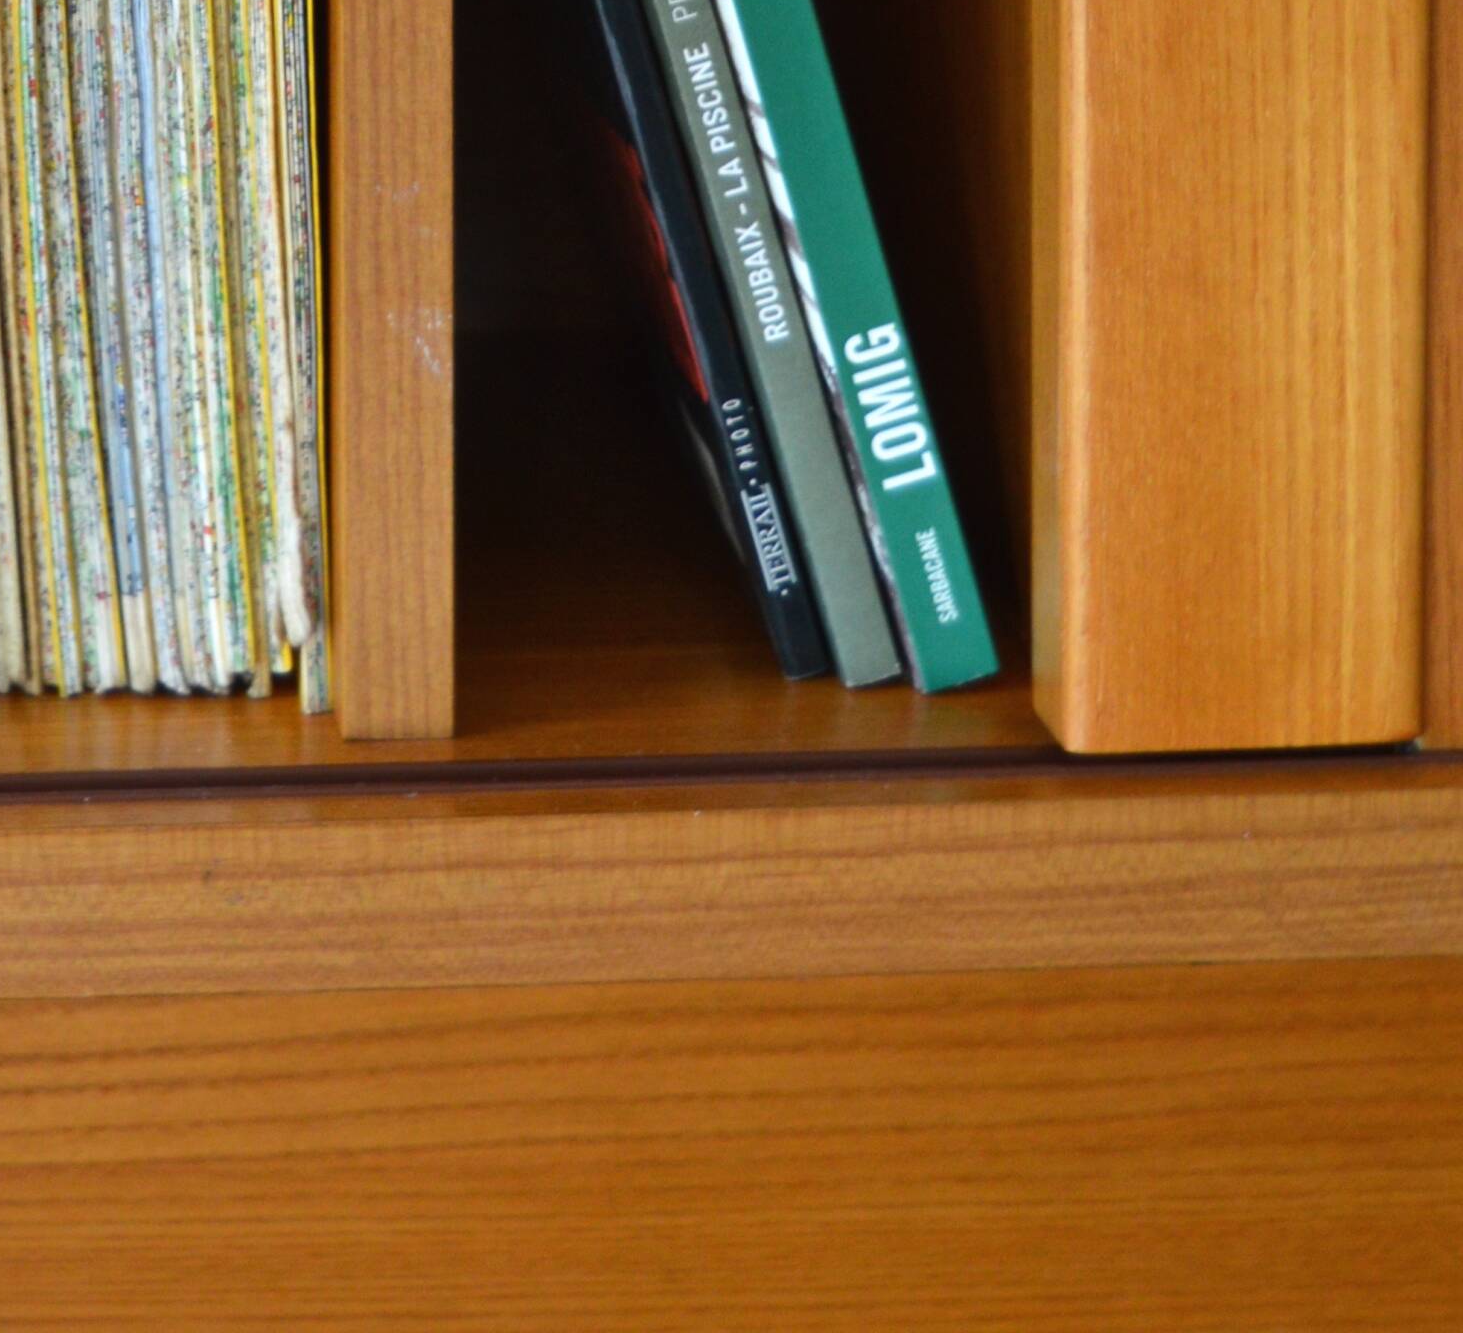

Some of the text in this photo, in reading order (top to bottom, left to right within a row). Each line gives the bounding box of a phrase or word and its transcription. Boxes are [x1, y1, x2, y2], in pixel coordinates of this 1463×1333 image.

[683, 42, 738, 153] PISCINE
[718, 155, 750, 201] LA
[735, 221, 789, 342] ROUBAIX
[844, 322, 937, 491] LOMIG
[722, 398, 791, 586] TERRAIL PHOTO
[915, 527, 959, 623] SARBACANE
